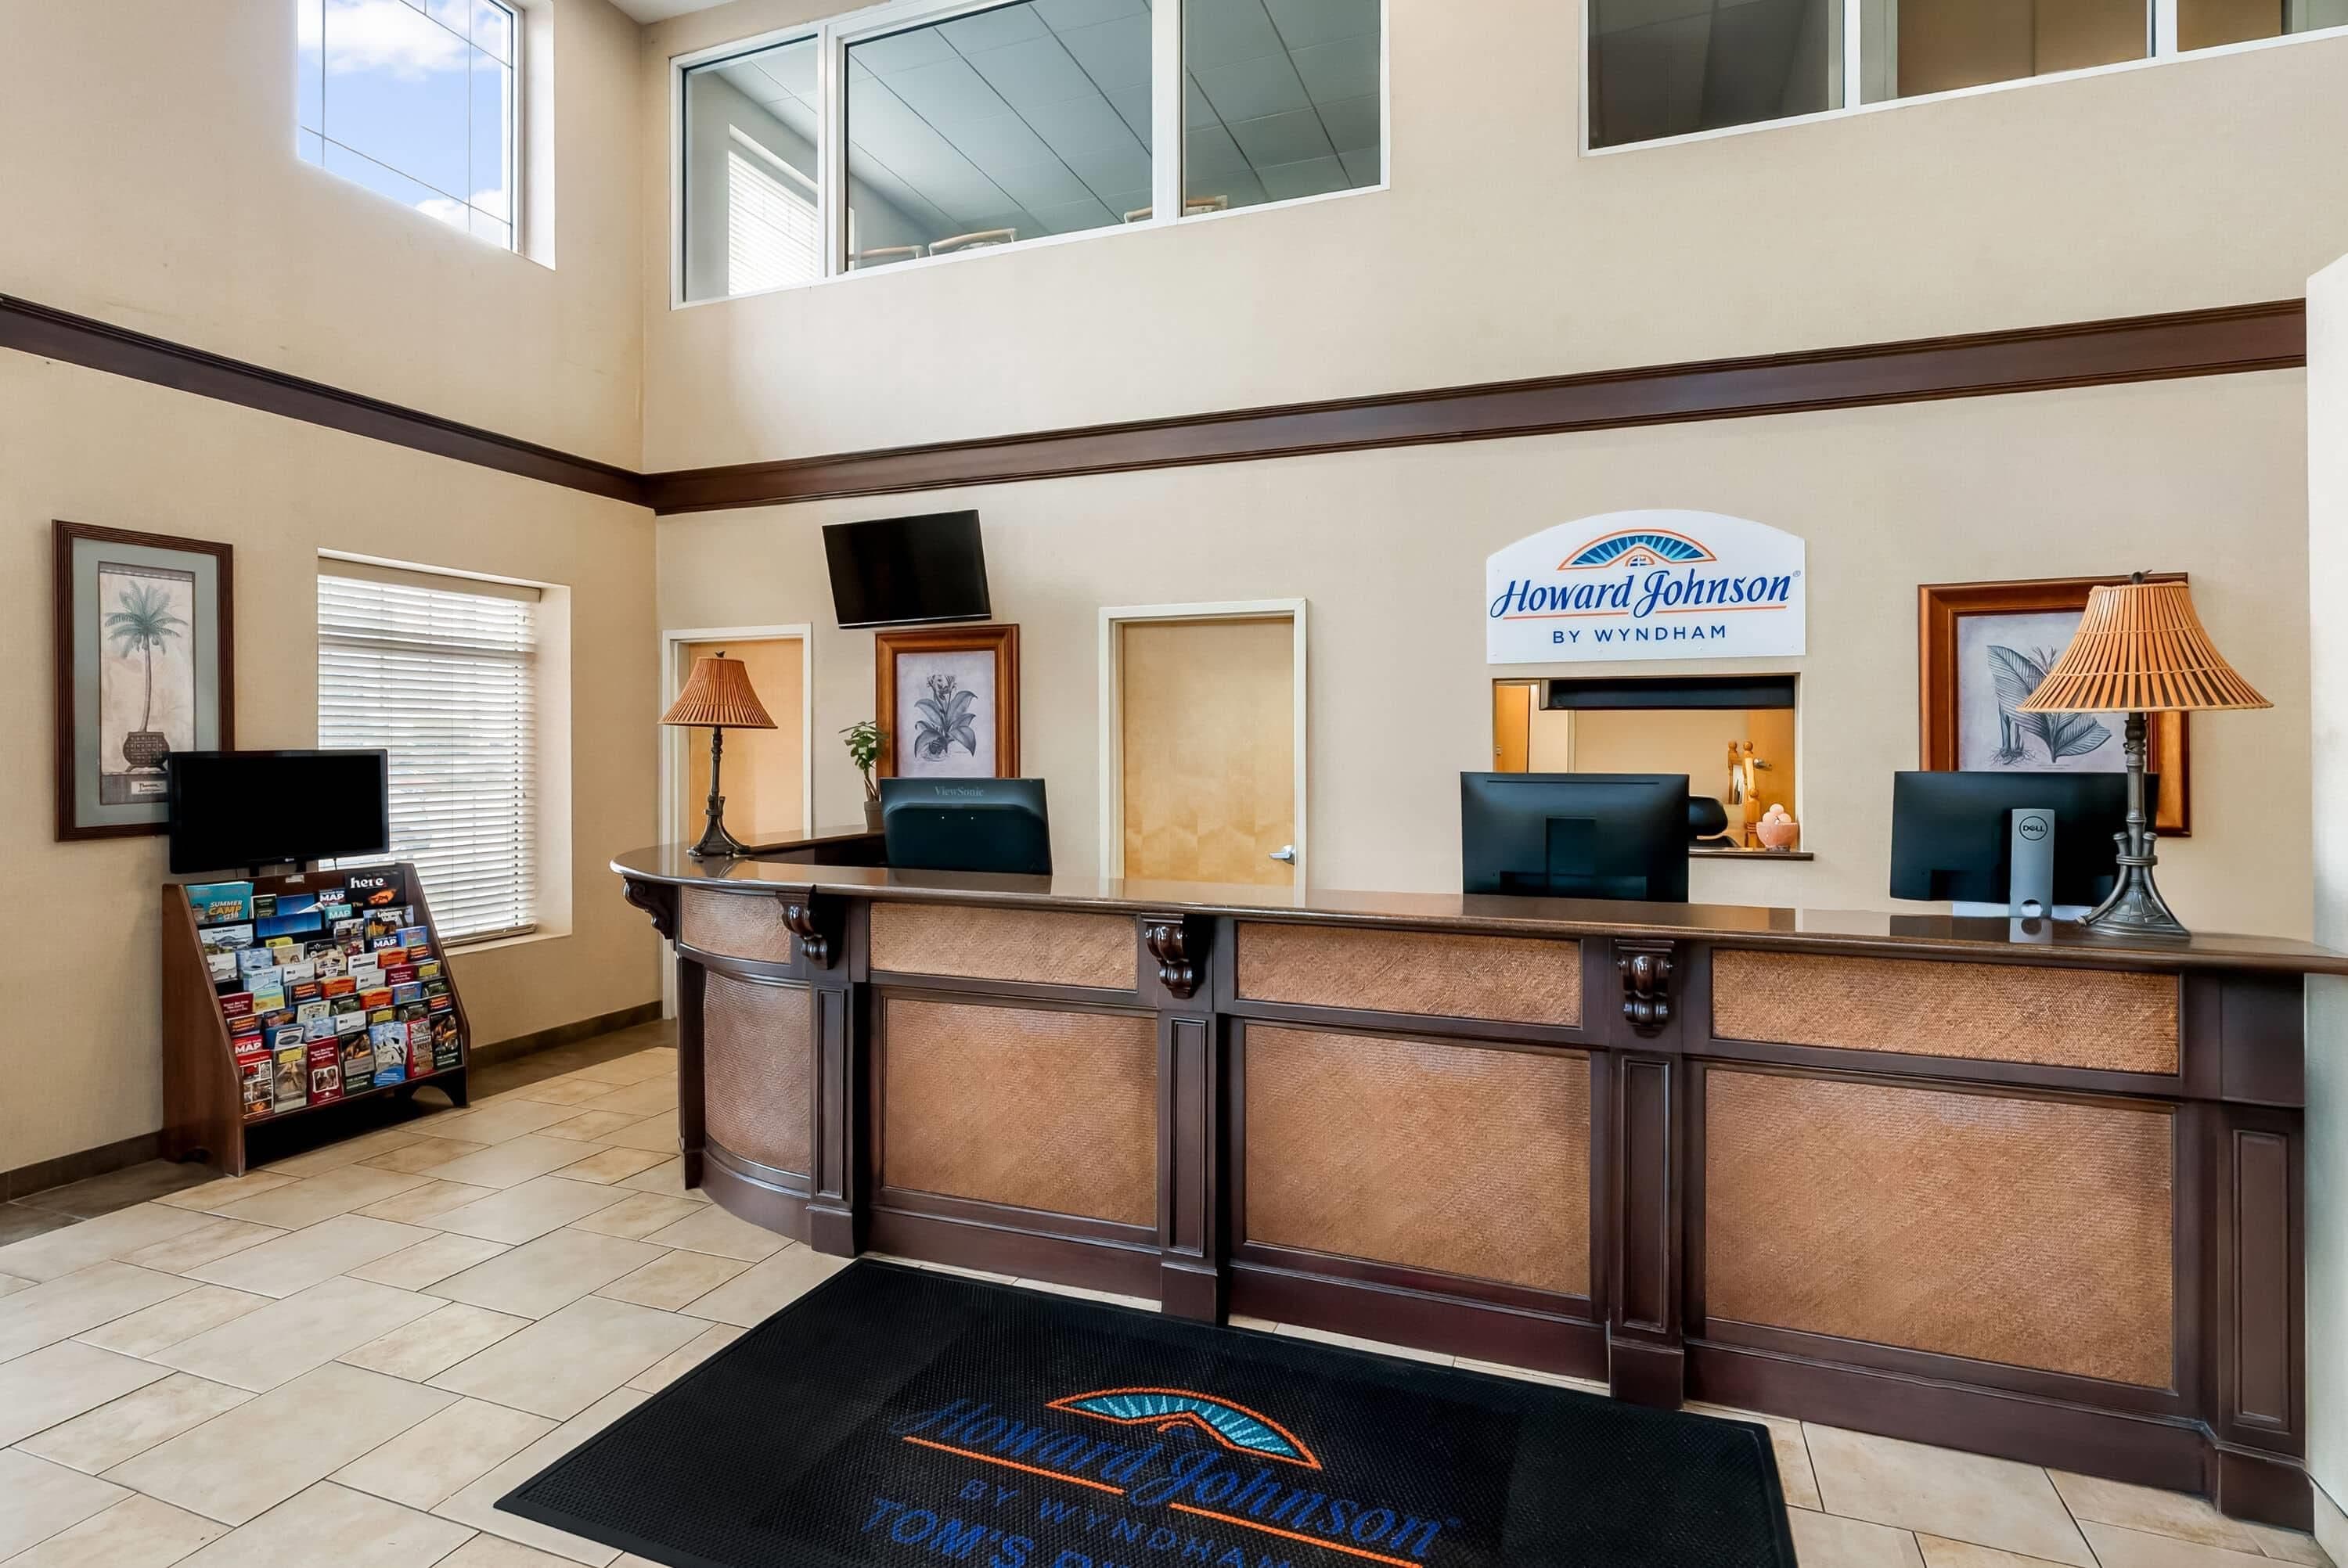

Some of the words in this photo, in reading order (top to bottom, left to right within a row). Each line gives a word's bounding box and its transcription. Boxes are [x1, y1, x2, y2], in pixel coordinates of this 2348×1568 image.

[1489, 574, 1634, 618] Howard
[1553, 629, 1581, 644] BY
[1594, 625, 1726, 643] WYNDHAM
[935, 786, 985, 797] ViewSonic
[319, 893, 345, 902] MAP
[208, 906, 242, 915] CAMP
[329, 910, 351, 919] MAP
[373, 938, 397, 948] MAP
[235, 1042, 262, 1054] MAP
[888, 1398, 1163, 1483] Howard
[959, 1479, 1018, 1507] BY
[861, 1496, 1034, 1568] TOM'S
